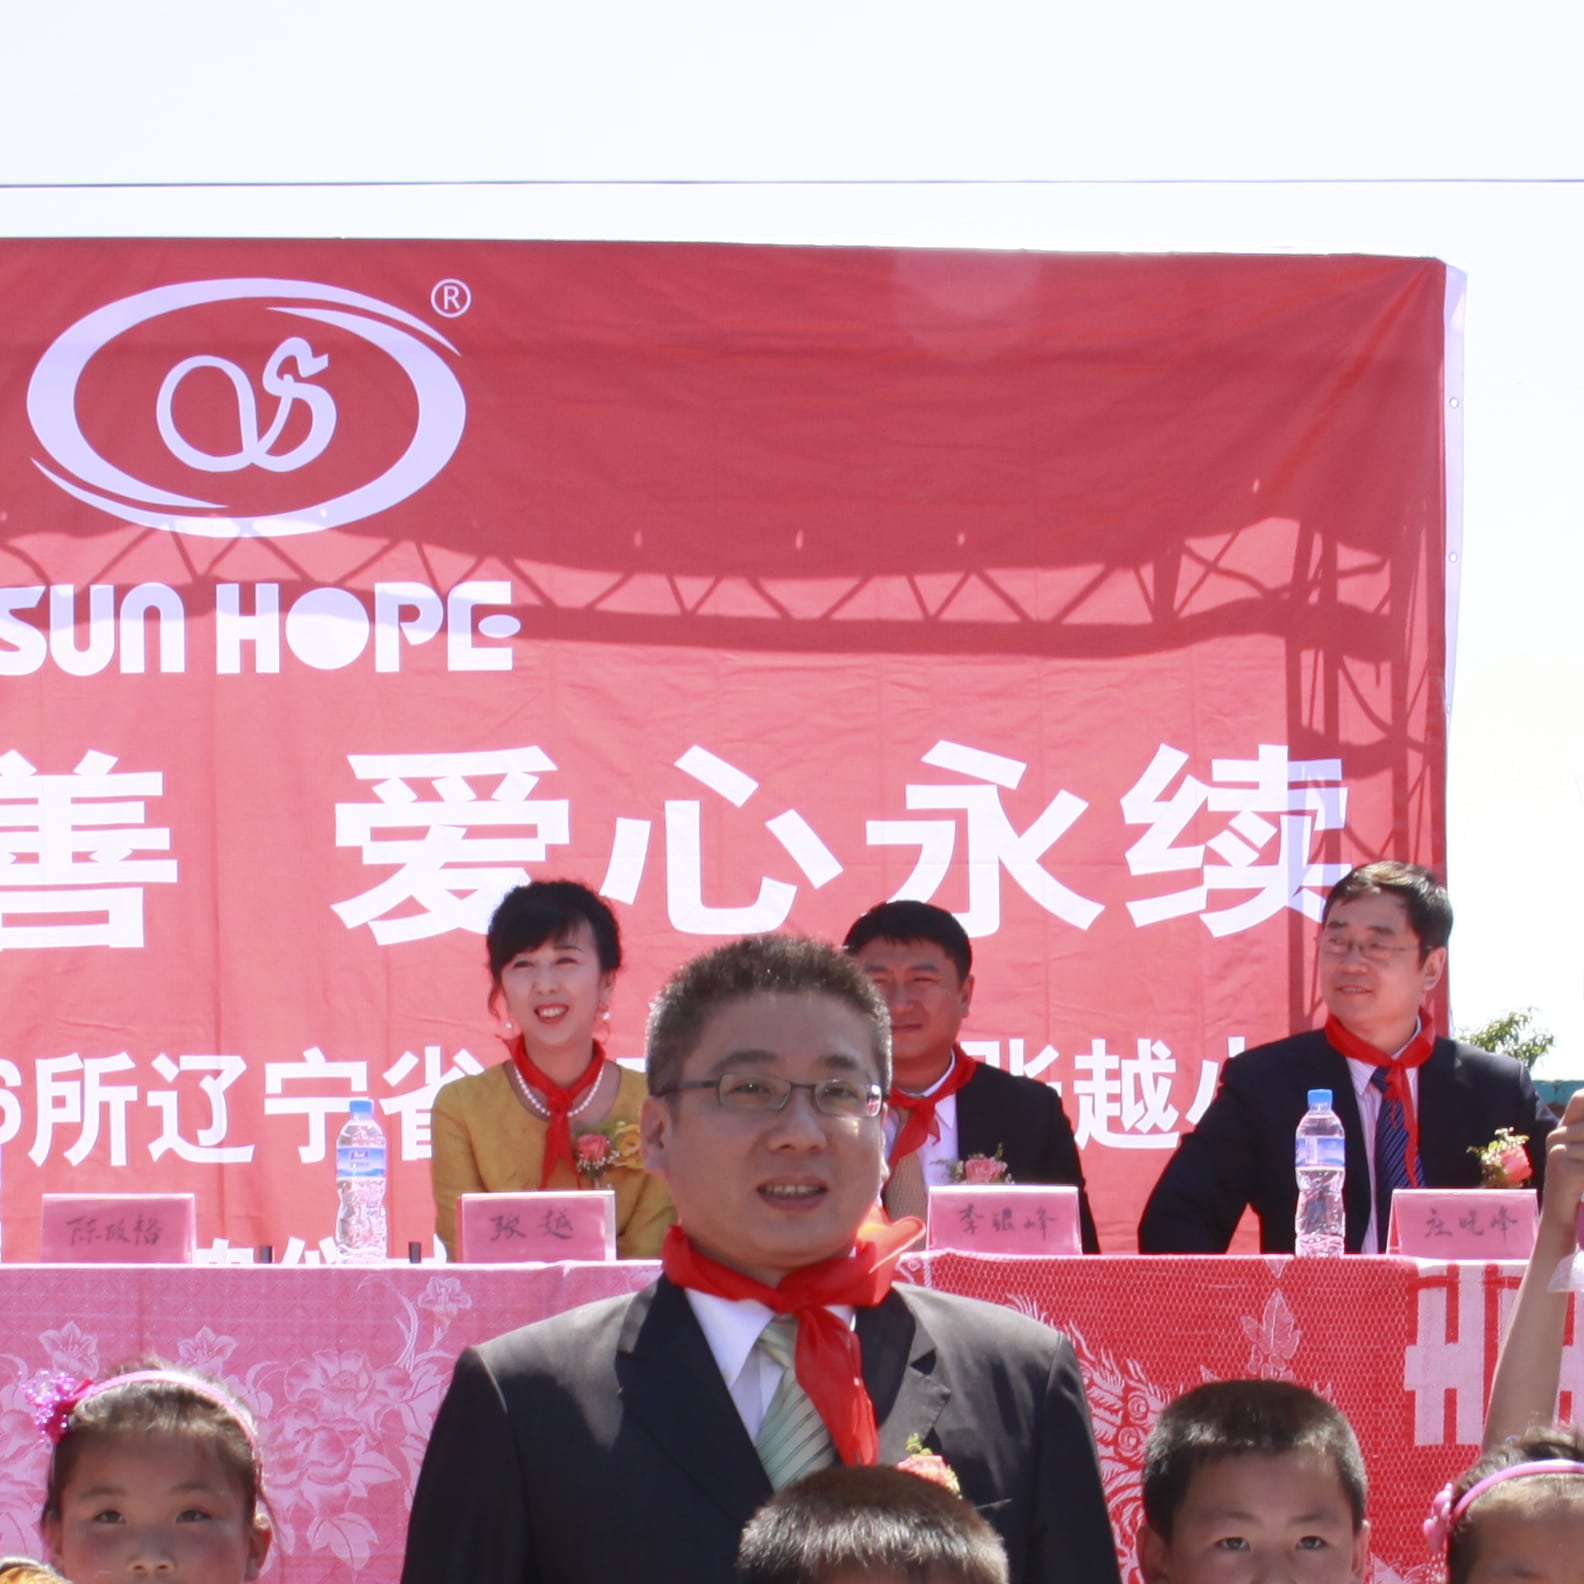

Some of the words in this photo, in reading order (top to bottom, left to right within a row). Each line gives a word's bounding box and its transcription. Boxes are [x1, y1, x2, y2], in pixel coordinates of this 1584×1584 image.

[218, 580, 522, 674] HOPE
[331, 738, 1354, 947] 爱心永续
